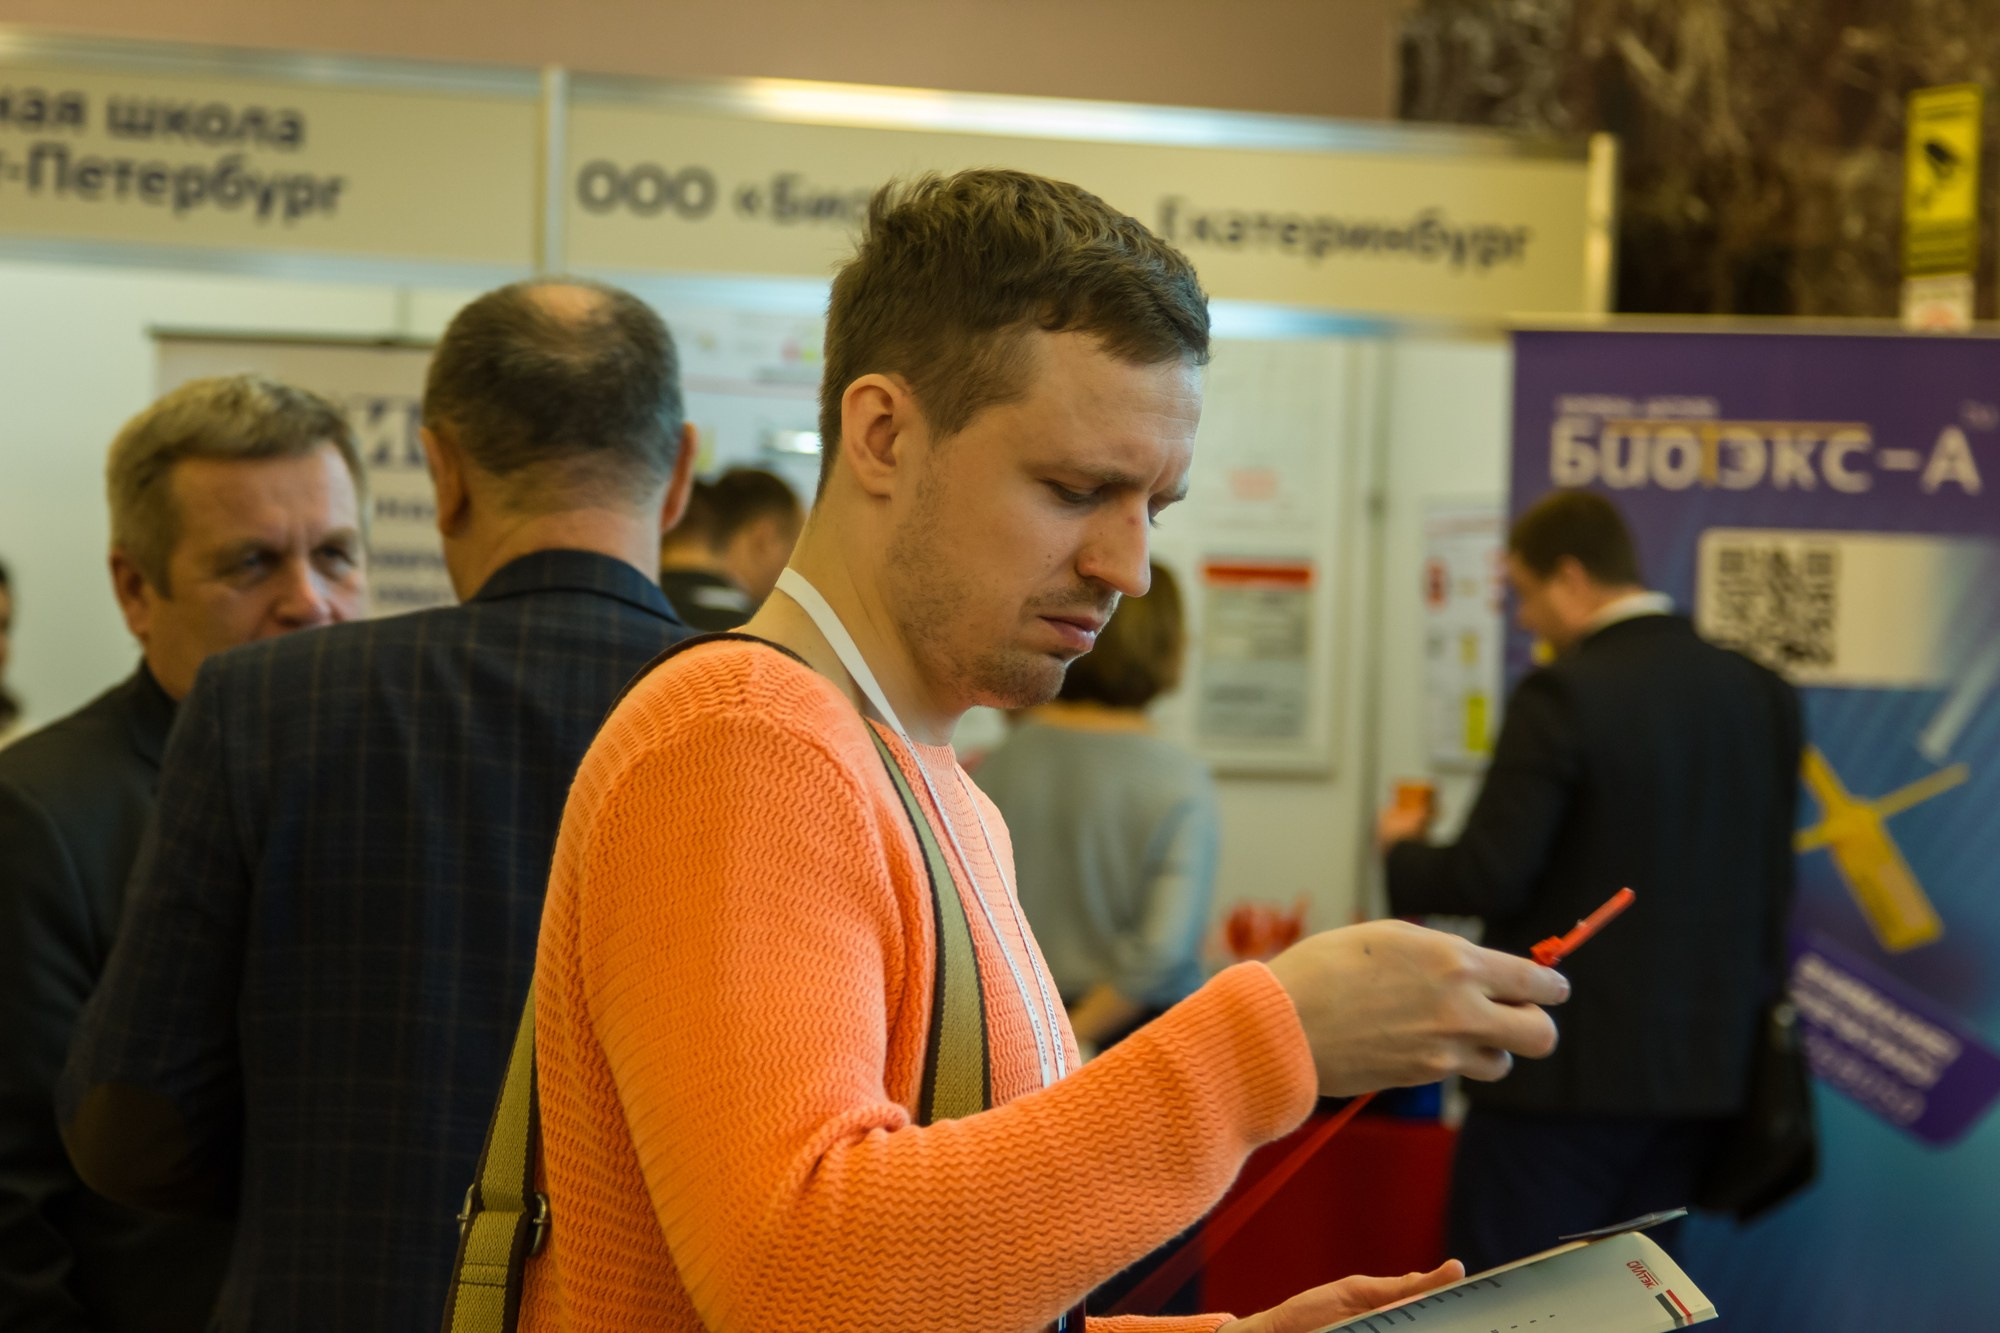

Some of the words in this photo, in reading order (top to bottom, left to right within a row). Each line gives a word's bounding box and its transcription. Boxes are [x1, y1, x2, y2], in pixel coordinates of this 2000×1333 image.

[105, 94, 307, 152] школа
[575, 158, 717, 222] ООО
[1626, 1260, 1659, 1289] СИЛТЭК
